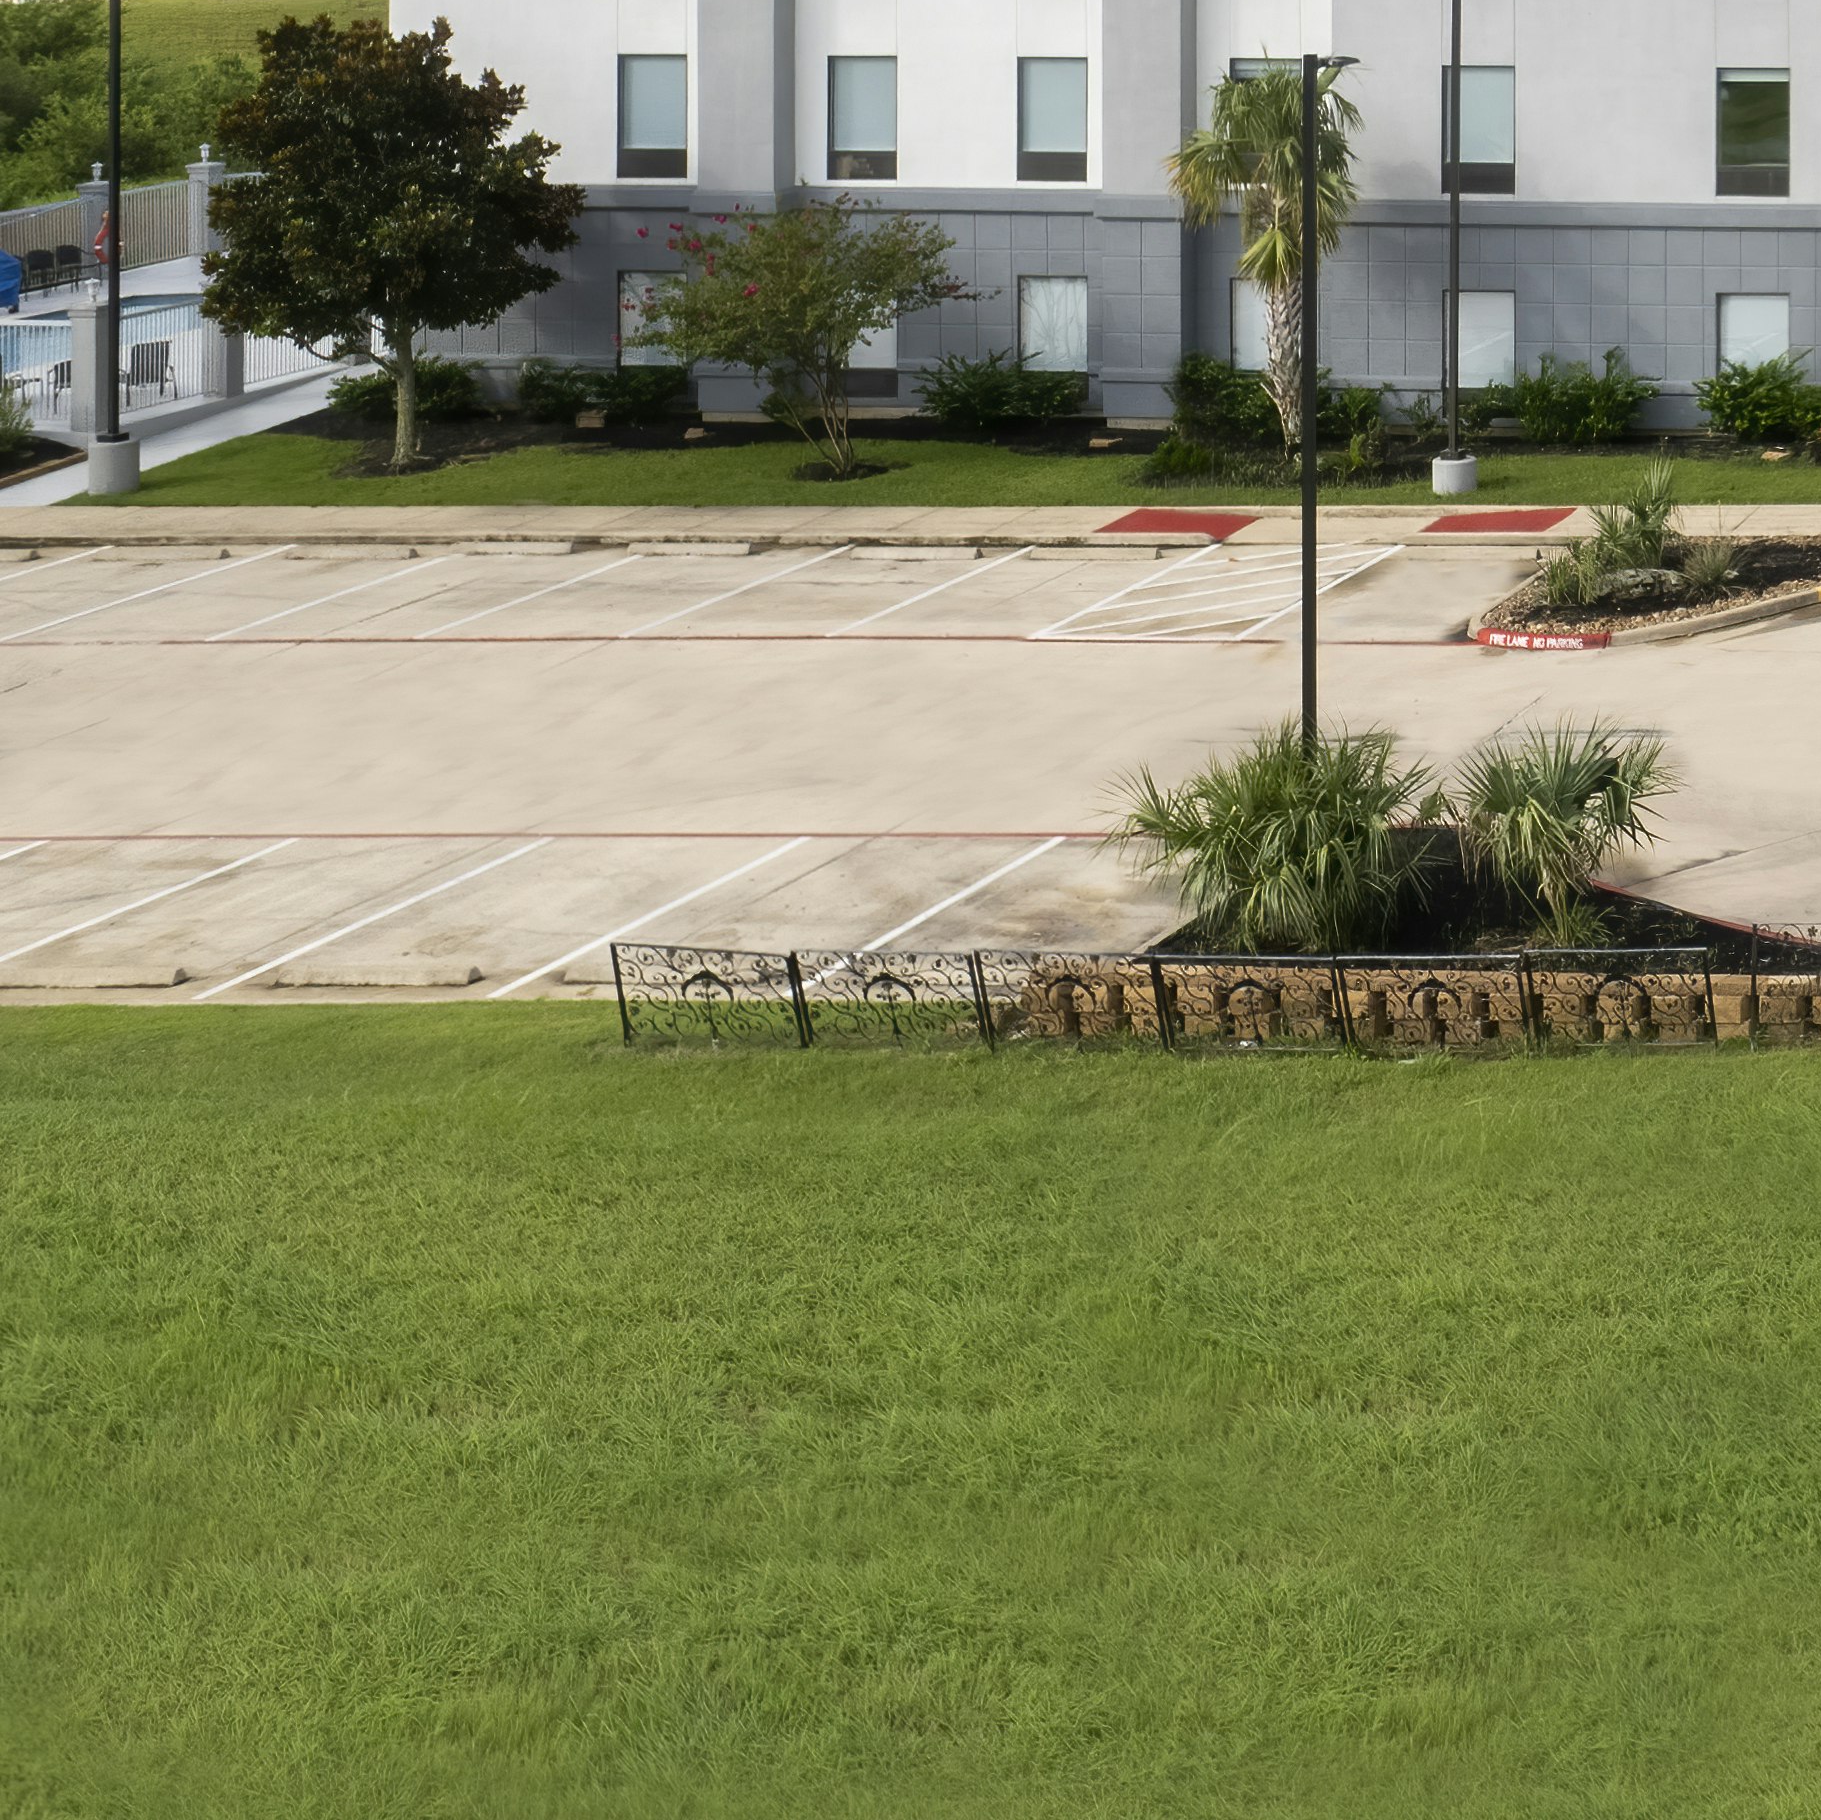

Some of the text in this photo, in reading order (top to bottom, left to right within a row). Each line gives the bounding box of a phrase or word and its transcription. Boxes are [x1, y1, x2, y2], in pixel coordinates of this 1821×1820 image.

[1507, 634, 1529, 648] LANE
[1533, 636, 1545, 649] NO
[1546, 636, 1584, 650] PARKING
